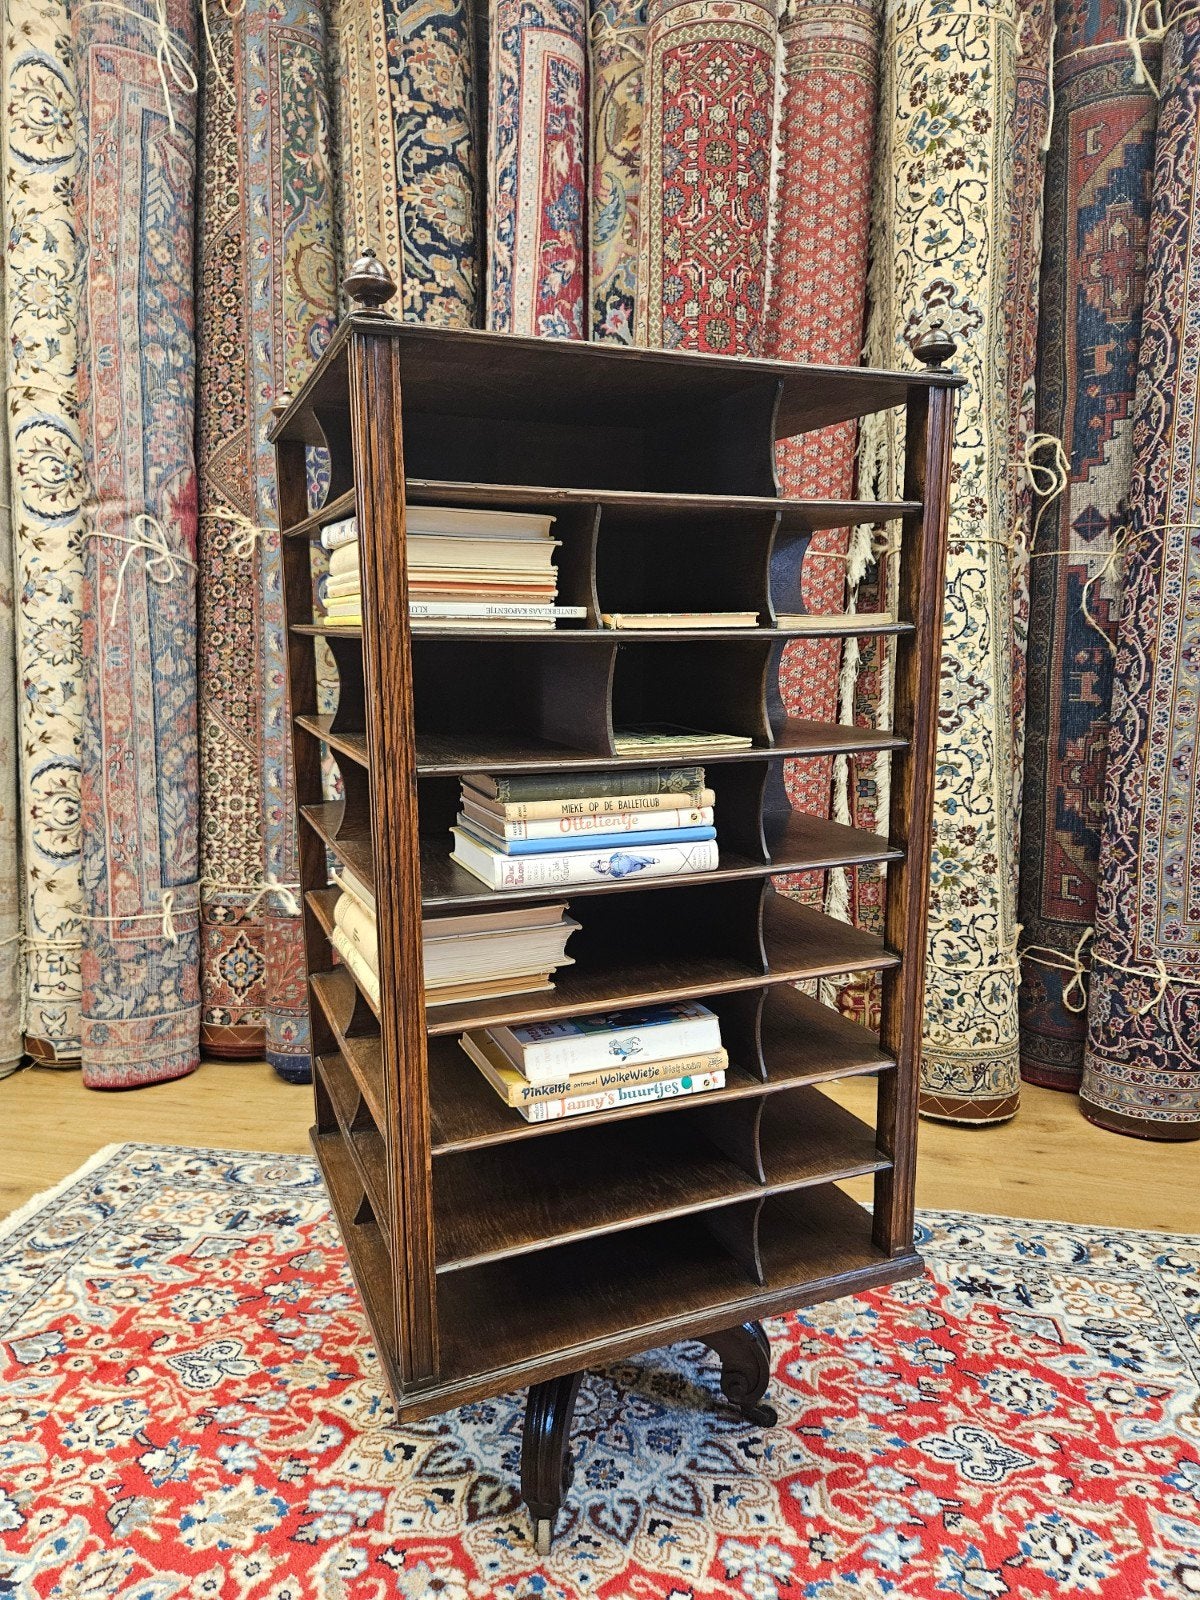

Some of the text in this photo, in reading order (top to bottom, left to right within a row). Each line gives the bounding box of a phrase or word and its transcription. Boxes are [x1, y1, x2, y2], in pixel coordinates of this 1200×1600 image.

[408, 603, 578, 615] SINTERKLAAS KAPOENTJE KLU
[561, 797, 660, 814] MIEKE OP DE BALLETCLUB
[559, 813, 639, 833] Ottelientje
[521, 1082, 571, 1100] Pinkeltje
[600, 1066, 660, 1086] WolkeWietje
[557, 1092, 615, 1117] Janny's
[618, 1081, 679, 1101] buurtjes
